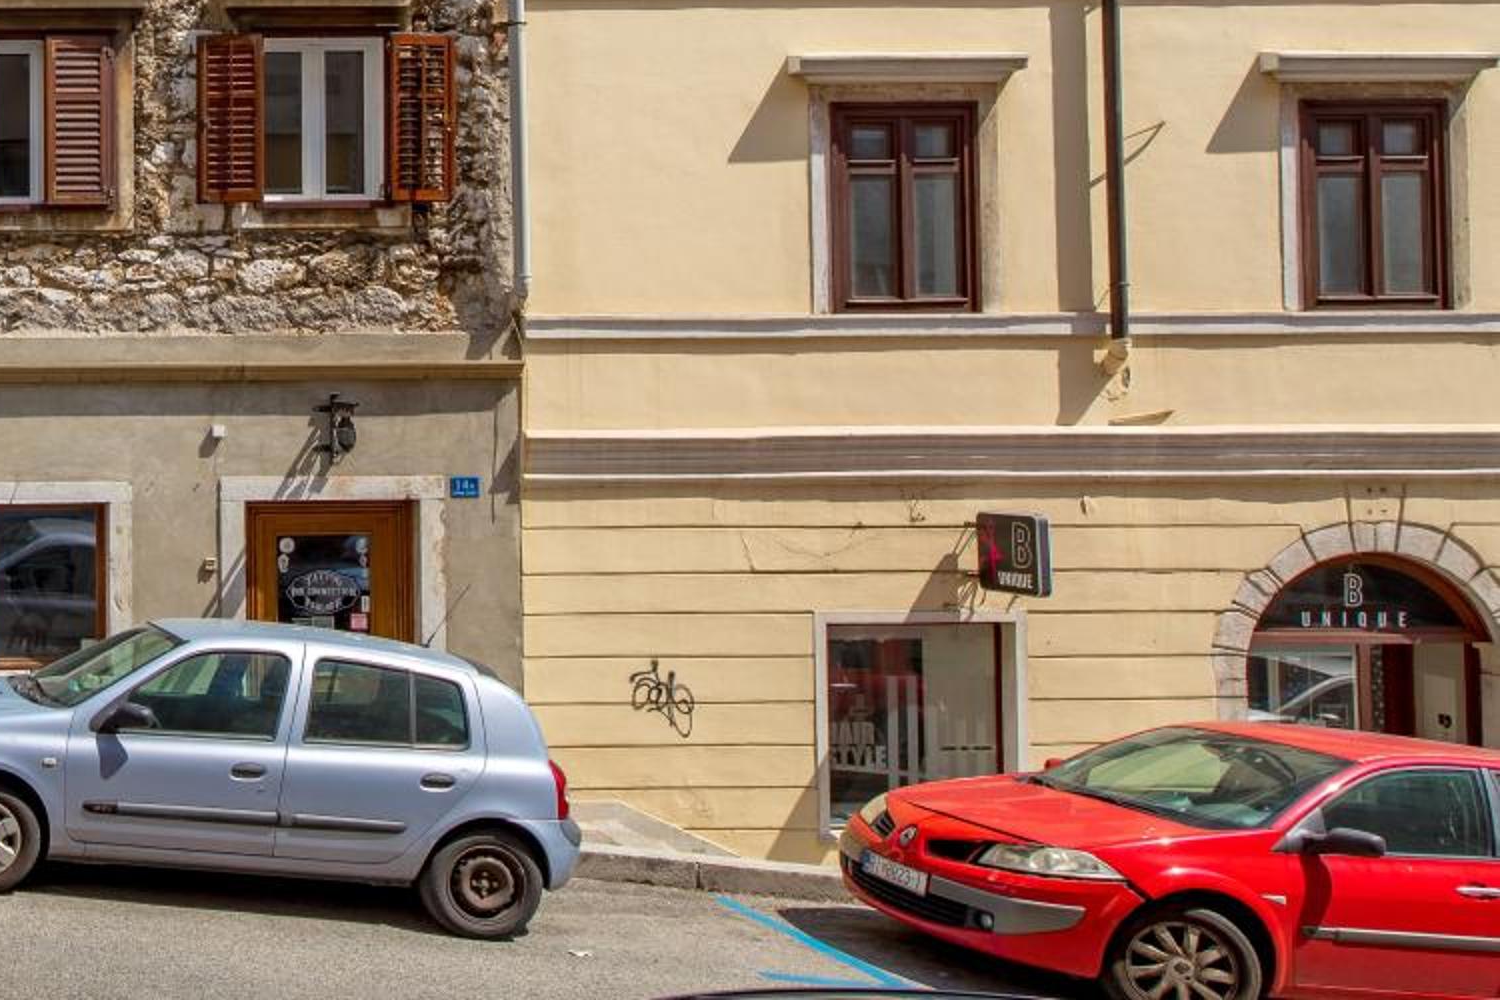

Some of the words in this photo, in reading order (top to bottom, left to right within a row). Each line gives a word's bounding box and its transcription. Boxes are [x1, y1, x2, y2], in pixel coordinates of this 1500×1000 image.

[1011, 521, 1034, 569] B
[1343, 573, 1364, 607] B
[1301, 611, 1408, 628] UNIQUE
